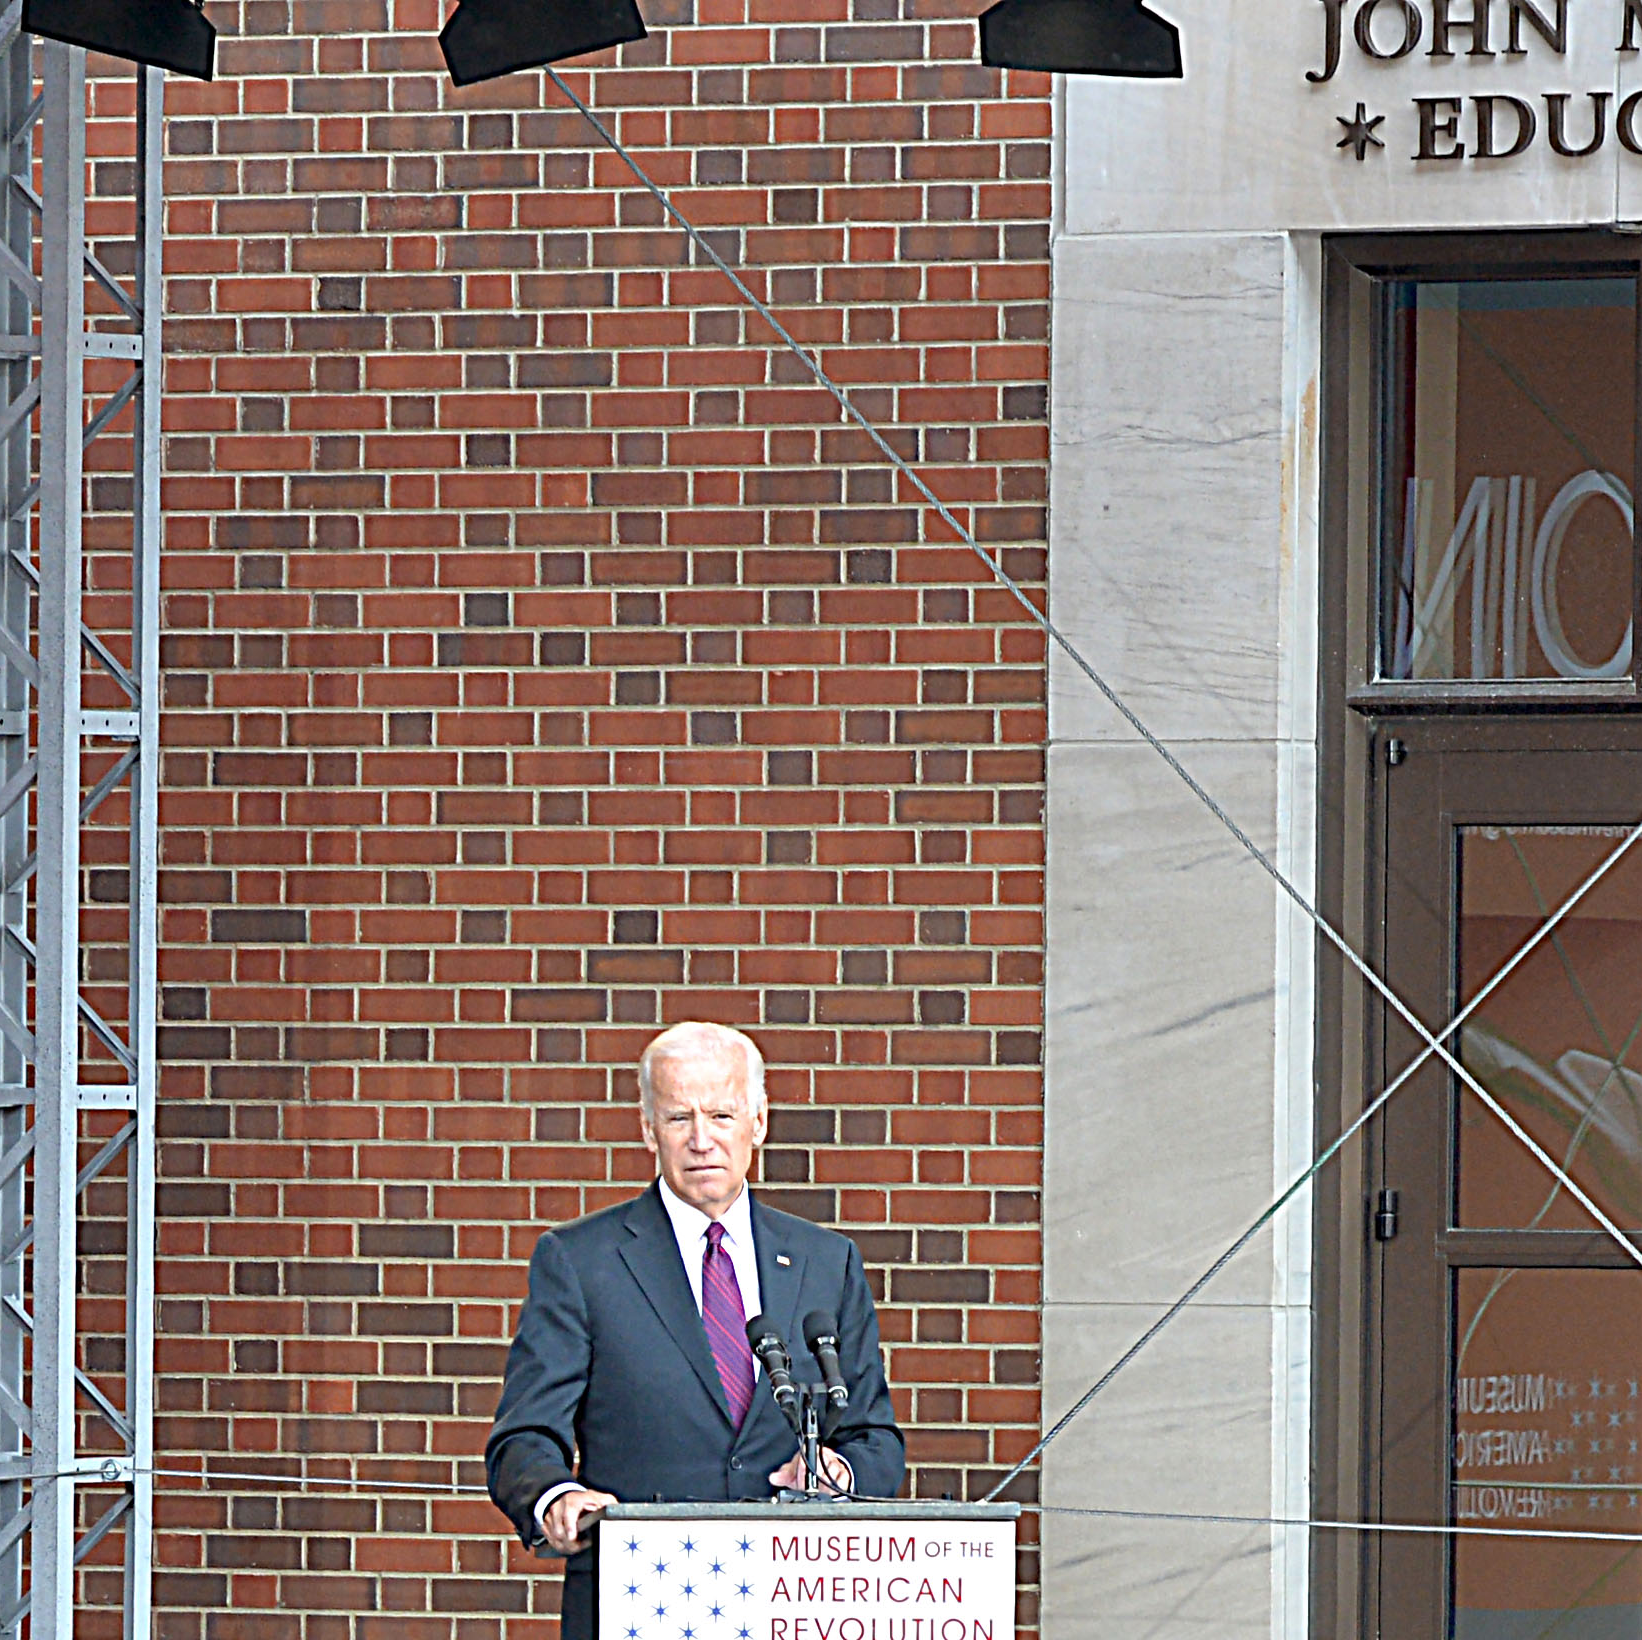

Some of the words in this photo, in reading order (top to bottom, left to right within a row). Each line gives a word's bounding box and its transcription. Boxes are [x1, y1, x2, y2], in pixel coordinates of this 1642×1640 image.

[1305, 0, 1567, 83] JOHN
[772, 1535, 916, 1563] MUSEUM
[924, 1540, 953, 1559] OF
[959, 1540, 995, 1559] THE
[770, 1576, 963, 1604] AMERICAN
